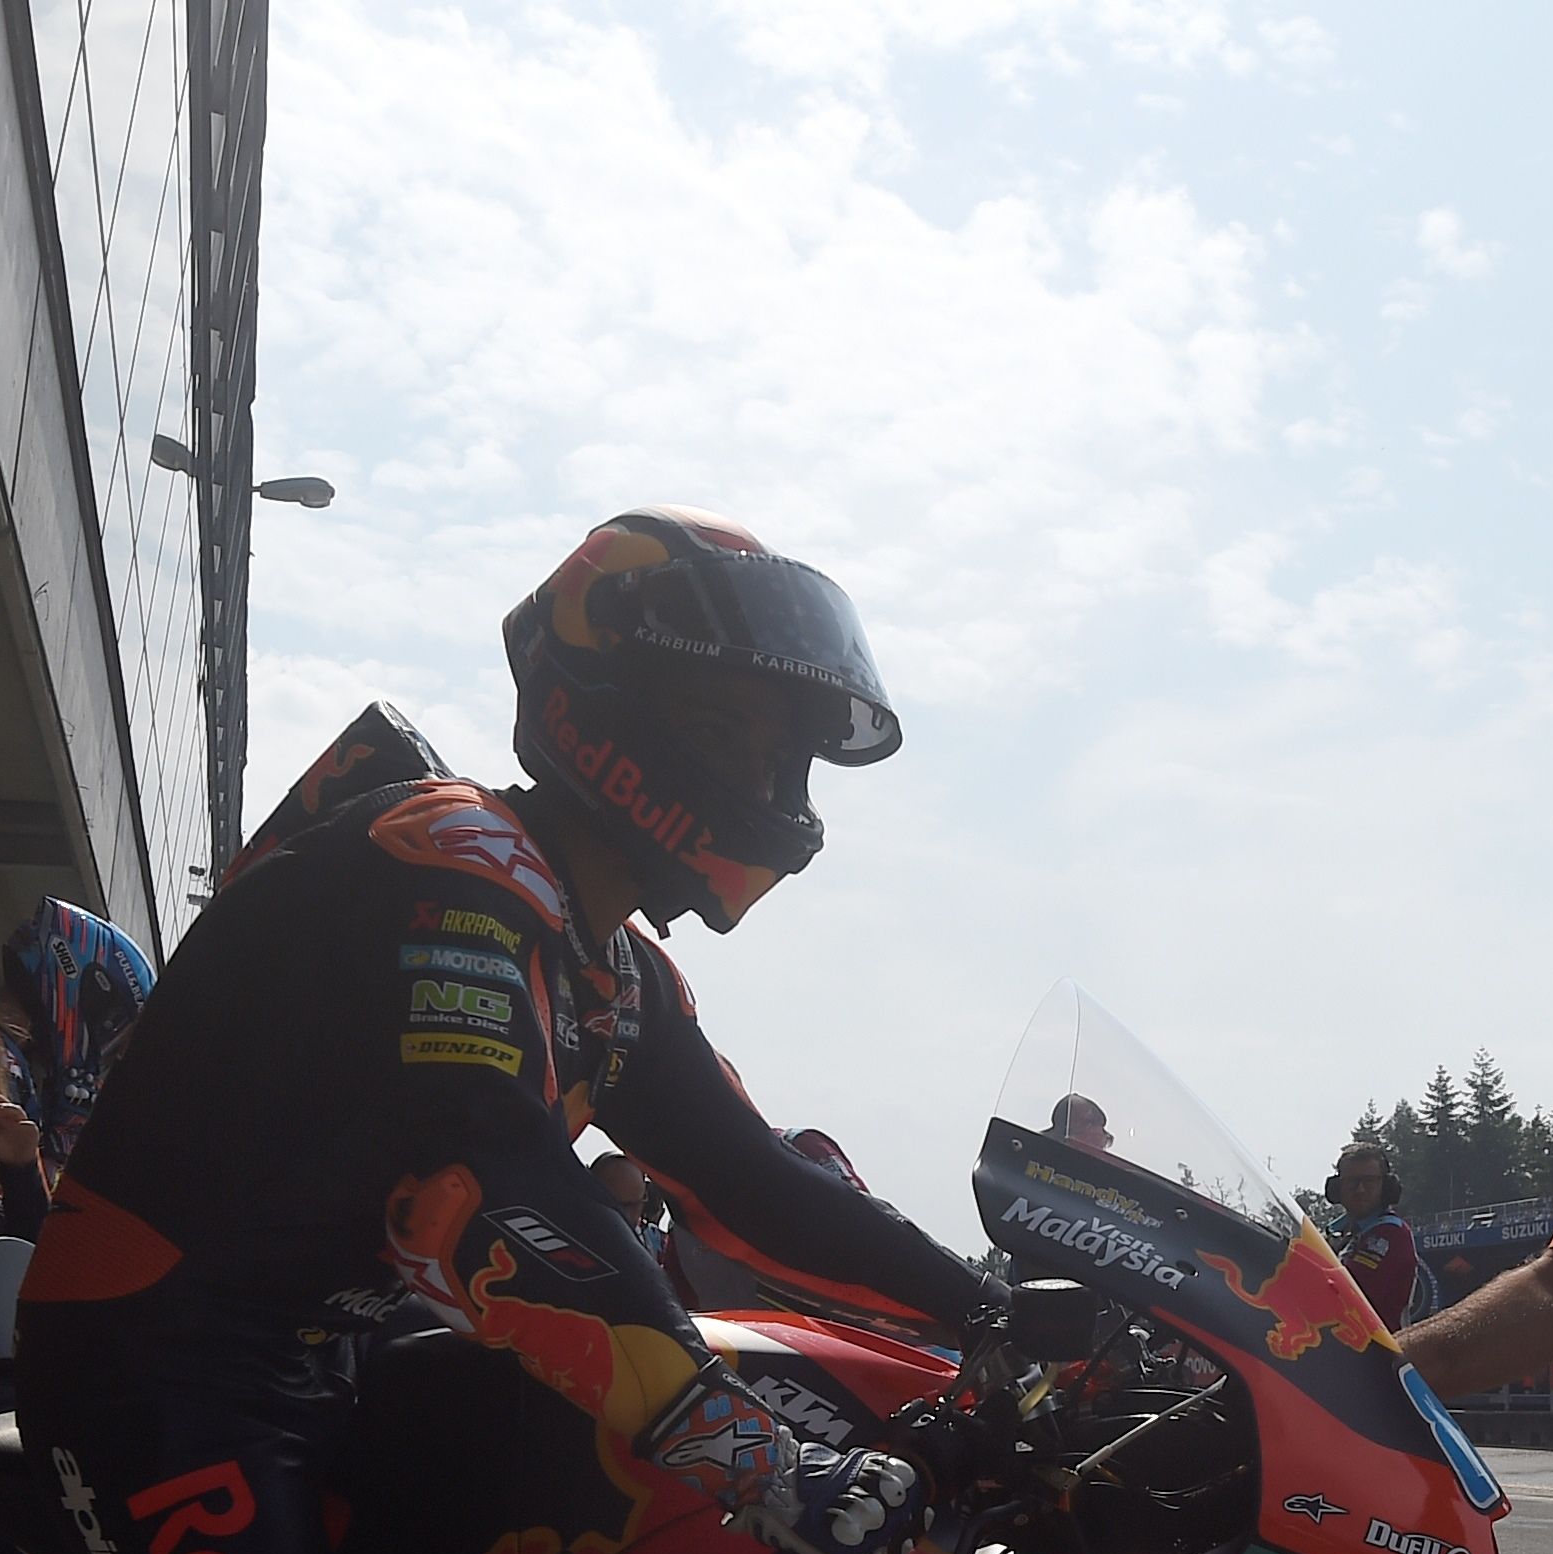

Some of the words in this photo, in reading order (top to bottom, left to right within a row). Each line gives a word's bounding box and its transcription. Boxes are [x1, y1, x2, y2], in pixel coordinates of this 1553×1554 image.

[635, 625, 721, 657] KARBIUM
[752, 652, 844, 688] KARBIUM
[543, 687, 613, 780] Red
[602, 755, 694, 850] Bull
[53, 941, 78, 976] SHOEI
[410, 979, 512, 1023] NG
[467, 1017, 510, 1035] Disc
[419, 1041, 514, 1062] DUNLOP
[1001, 1196, 1186, 1288] Malaysia
[1090, 1217, 1158, 1256] Visit
[1423, 1232, 1466, 1249] SUZUKI
[1502, 1221, 1550, 1241] SUZUKI
[749, 1374, 854, 1446] KTM
